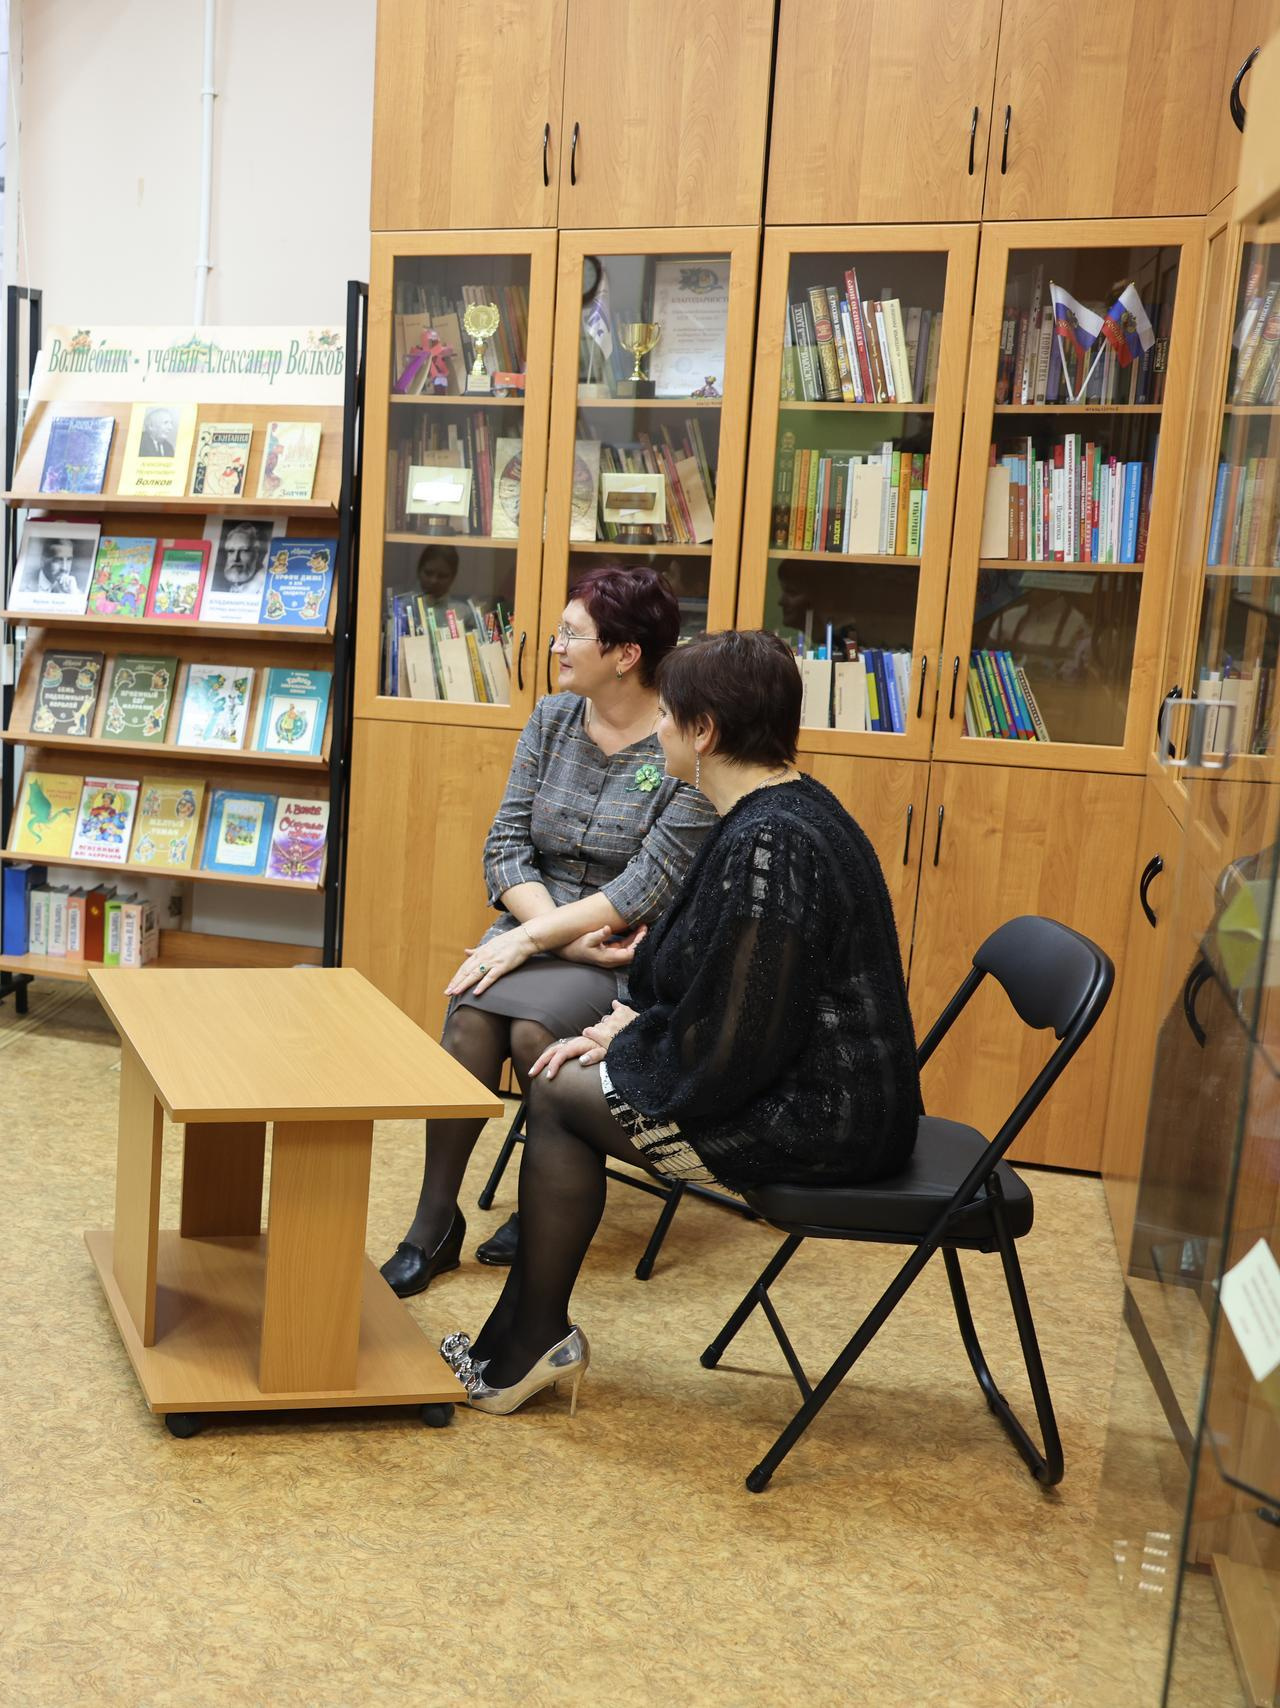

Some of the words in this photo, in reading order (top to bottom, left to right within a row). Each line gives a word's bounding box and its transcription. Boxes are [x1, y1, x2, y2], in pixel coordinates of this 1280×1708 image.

[47, 338, 132, 374] Волшебник
[199, 342, 283, 385] Александр
[286, 338, 345, 376] Волков
[135, 477, 174, 487] Волков
